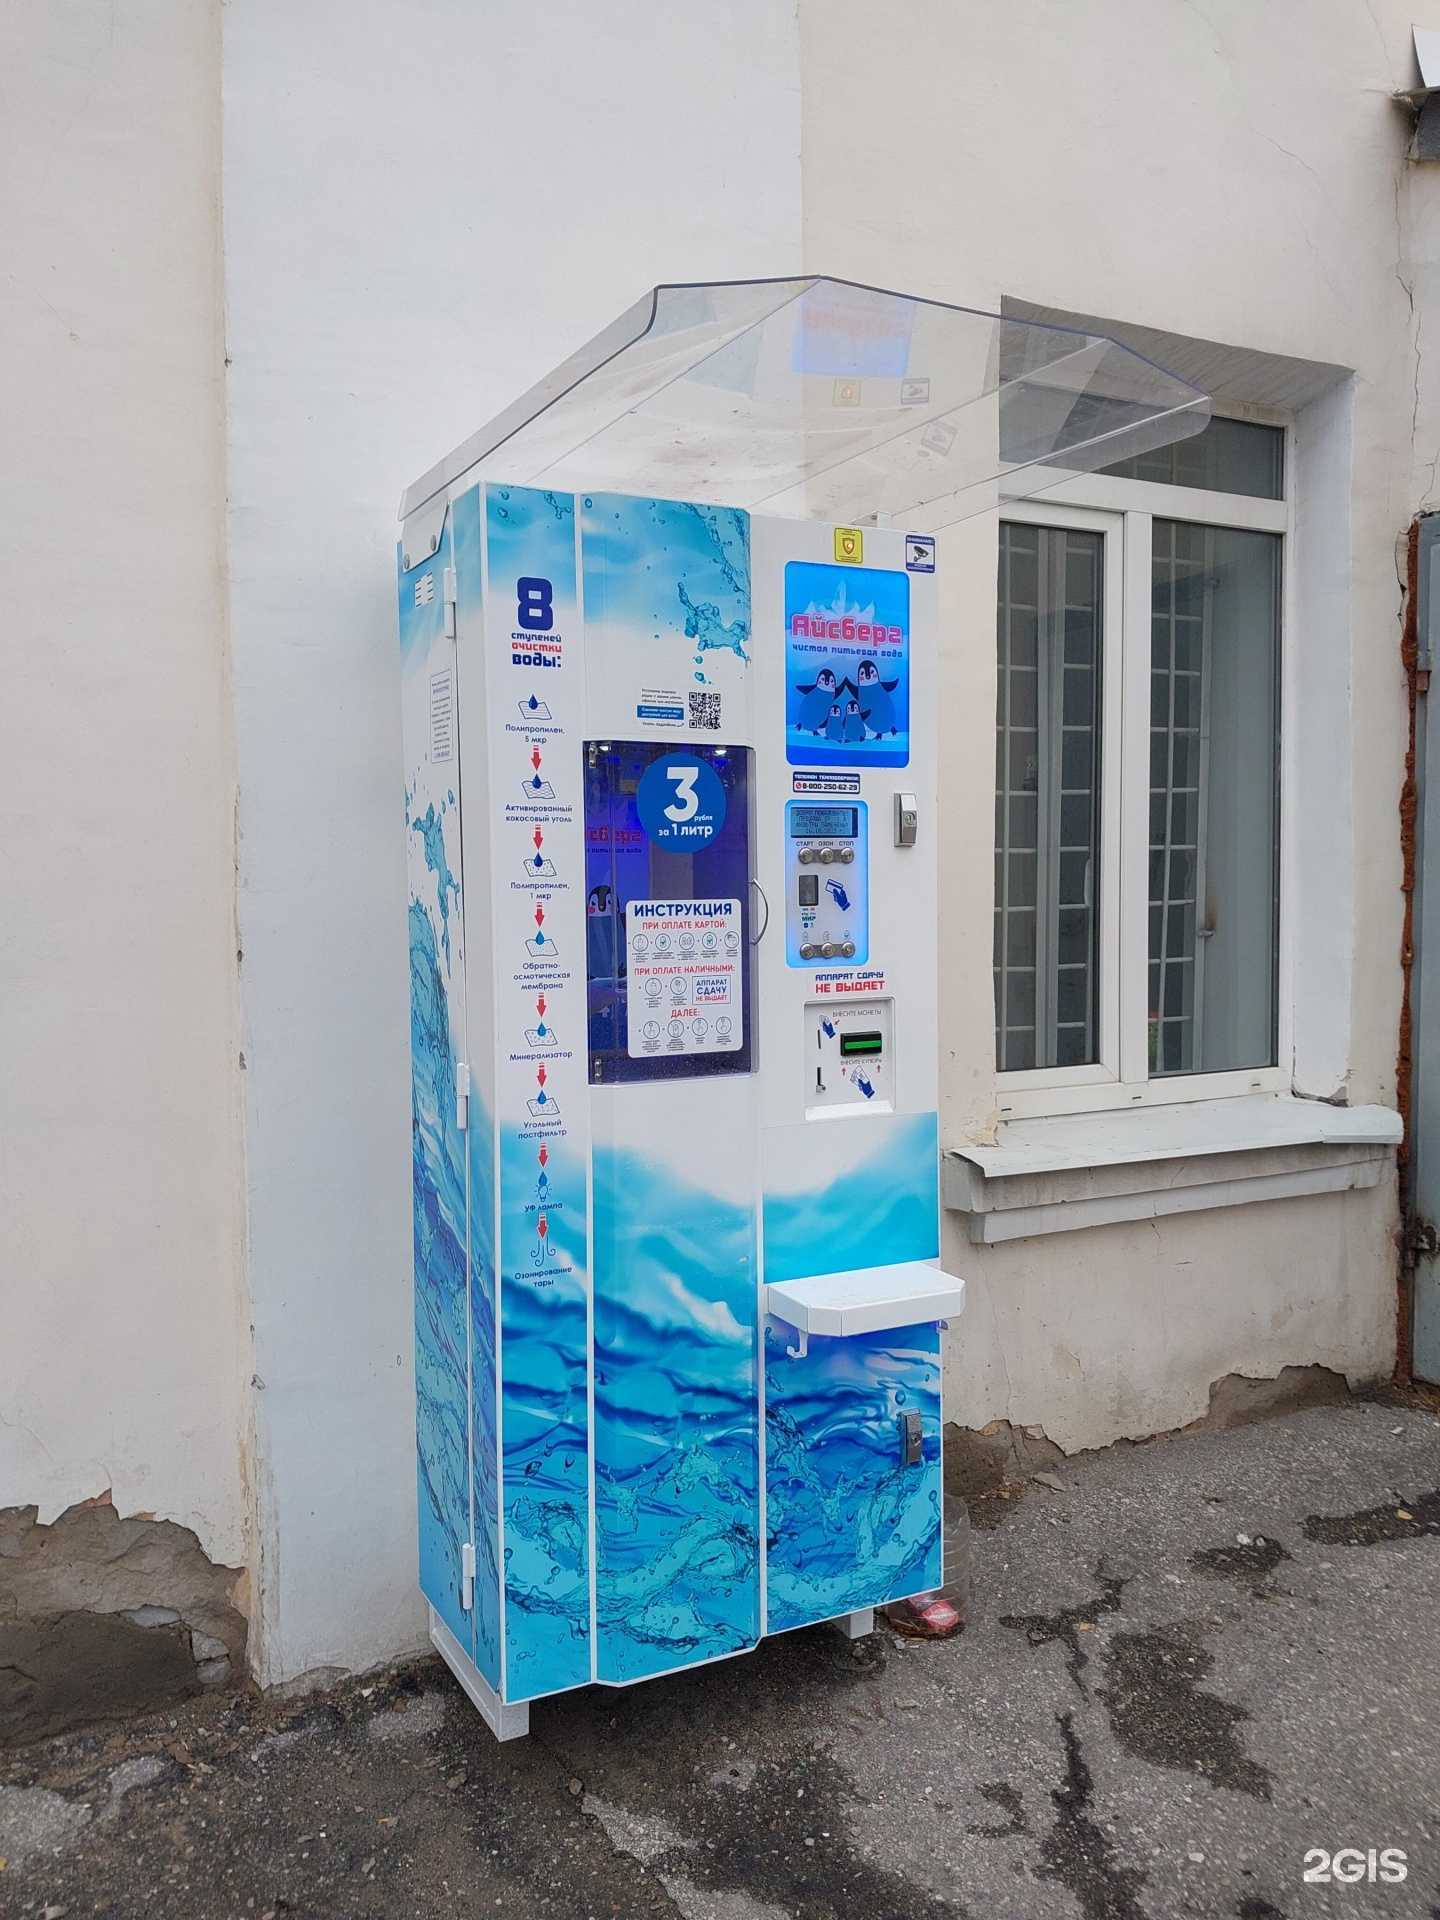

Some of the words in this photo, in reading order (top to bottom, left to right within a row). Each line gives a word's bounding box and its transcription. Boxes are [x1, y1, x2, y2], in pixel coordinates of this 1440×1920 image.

[517, 576, 553, 631] 8
[792, 614, 903, 647] Айсберг
[511, 632, 562, 644] ступеней
[511, 641, 562, 653] очистки
[793, 643, 828, 653] чистая
[831, 647, 878, 657] питьевая
[881, 650, 903, 658] вода
[512, 652, 562, 668] воды:
[531, 737, 547, 745] мкр
[664, 767, 699, 822] 3
[694, 814, 713, 823] рубля
[505, 804, 573, 813] Активированный
[506, 815, 550, 823] кокосовый
[658, 829, 670, 837] за
[671, 823, 678, 836] 1
[680, 825, 713, 838] литр
[634, 903, 732, 917] ИНСТРУКЦИЯ
[642, 922, 659, 930] ПРИ
[661, 920, 692, 930] ОПЛАТЕ
[694, 918, 728, 929] КАРТОЙ:
[634, 968, 650, 976] ПРИ
[652, 966, 682, 976] ОПЛАТЕ
[684, 964, 735, 974] НАЛИЧНЫМИ:
[513, 973, 571, 981] осмотическая
[815, 972, 854, 981] АППАРАТ
[856, 971, 884, 980] СДАЧУ
[521, 982, 563, 991] мембрана
[696, 978, 727, 987] АППАРАТ
[815, 983, 832, 993] НЕ
[835, 980, 886, 993] ВЫДАЕТ
[696, 986, 727, 995] СДАЧУ
[671, 1008, 700, 1019] ДАЛЕЕ:
[509, 1051, 573, 1061] Минерализатор
[523, 1119, 562, 1129] Угольный
[518, 1129, 567, 1140] постфильтр
[537, 1202, 563, 1211] лампа
[514, 1266, 573, 1280] Озонирование
[533, 1278, 555, 1288] тары
